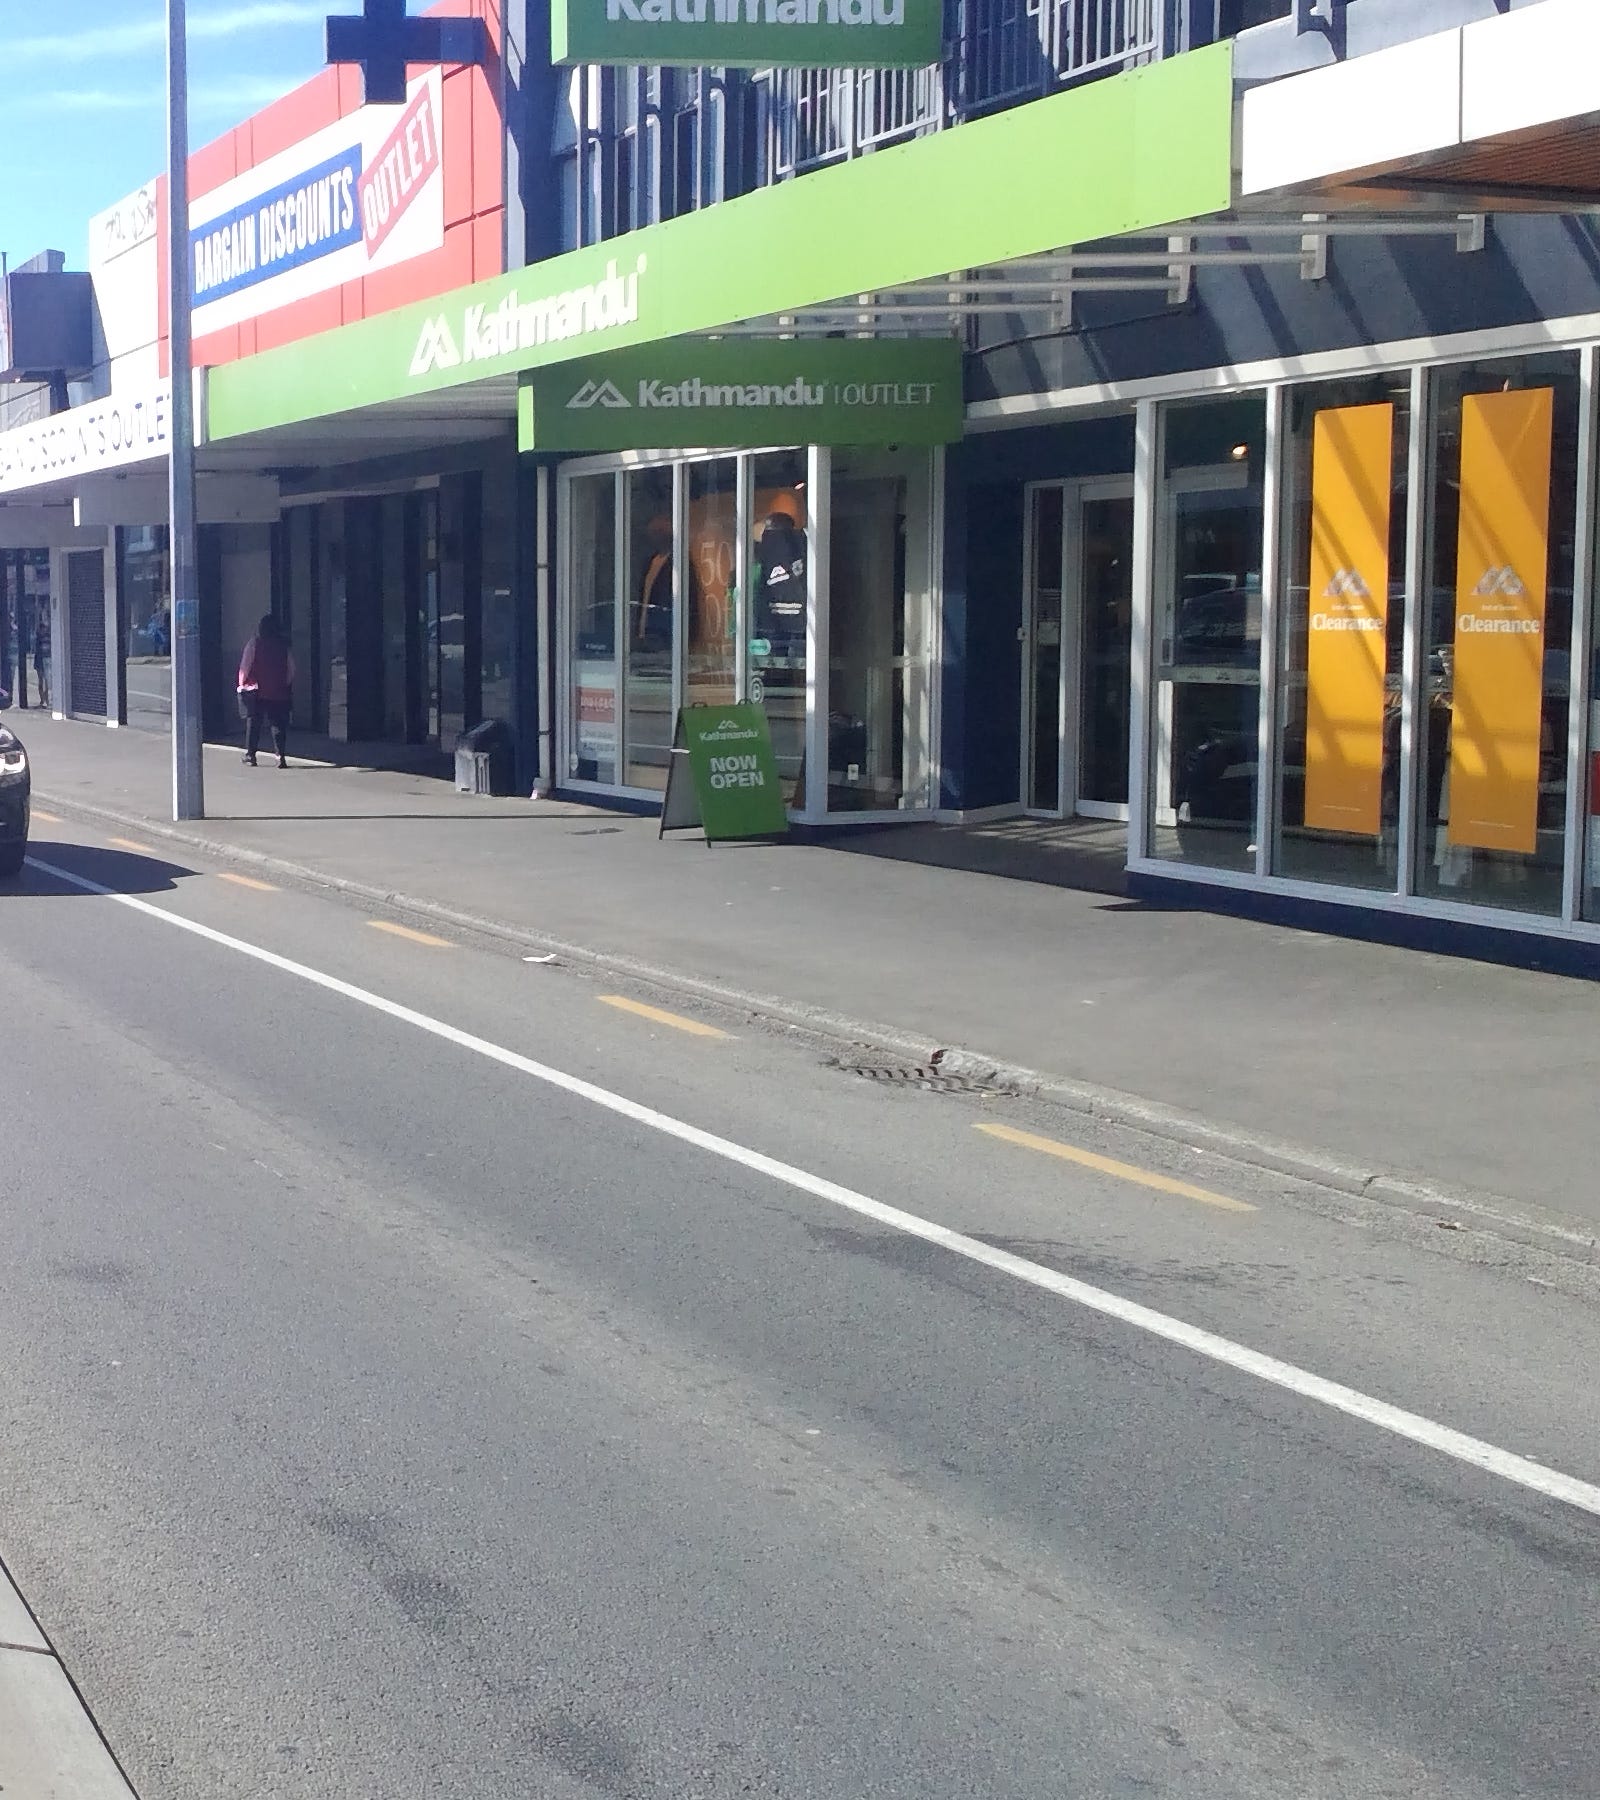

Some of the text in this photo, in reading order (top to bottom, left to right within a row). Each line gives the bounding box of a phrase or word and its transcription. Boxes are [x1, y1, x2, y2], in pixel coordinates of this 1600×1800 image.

[606, 0, 904, 25] Kathmandu
[362, 101, 432, 241] OUTLET
[194, 213, 256, 294] BARGAIN
[259, 166, 354, 267] DISCOUNTS
[462, 257, 639, 364] Kathmandu
[638, 377, 938, 408] Kathmandu OUTLET
[111, 393, 171, 452] OUTLE
[1311, 612, 1384, 632] Clearance
[1458, 613, 1540, 633] Clearance
[699, 729, 759, 743] Kathmandu
[709, 754, 758, 773] NOW
[710, 770, 765, 790] OPEN
